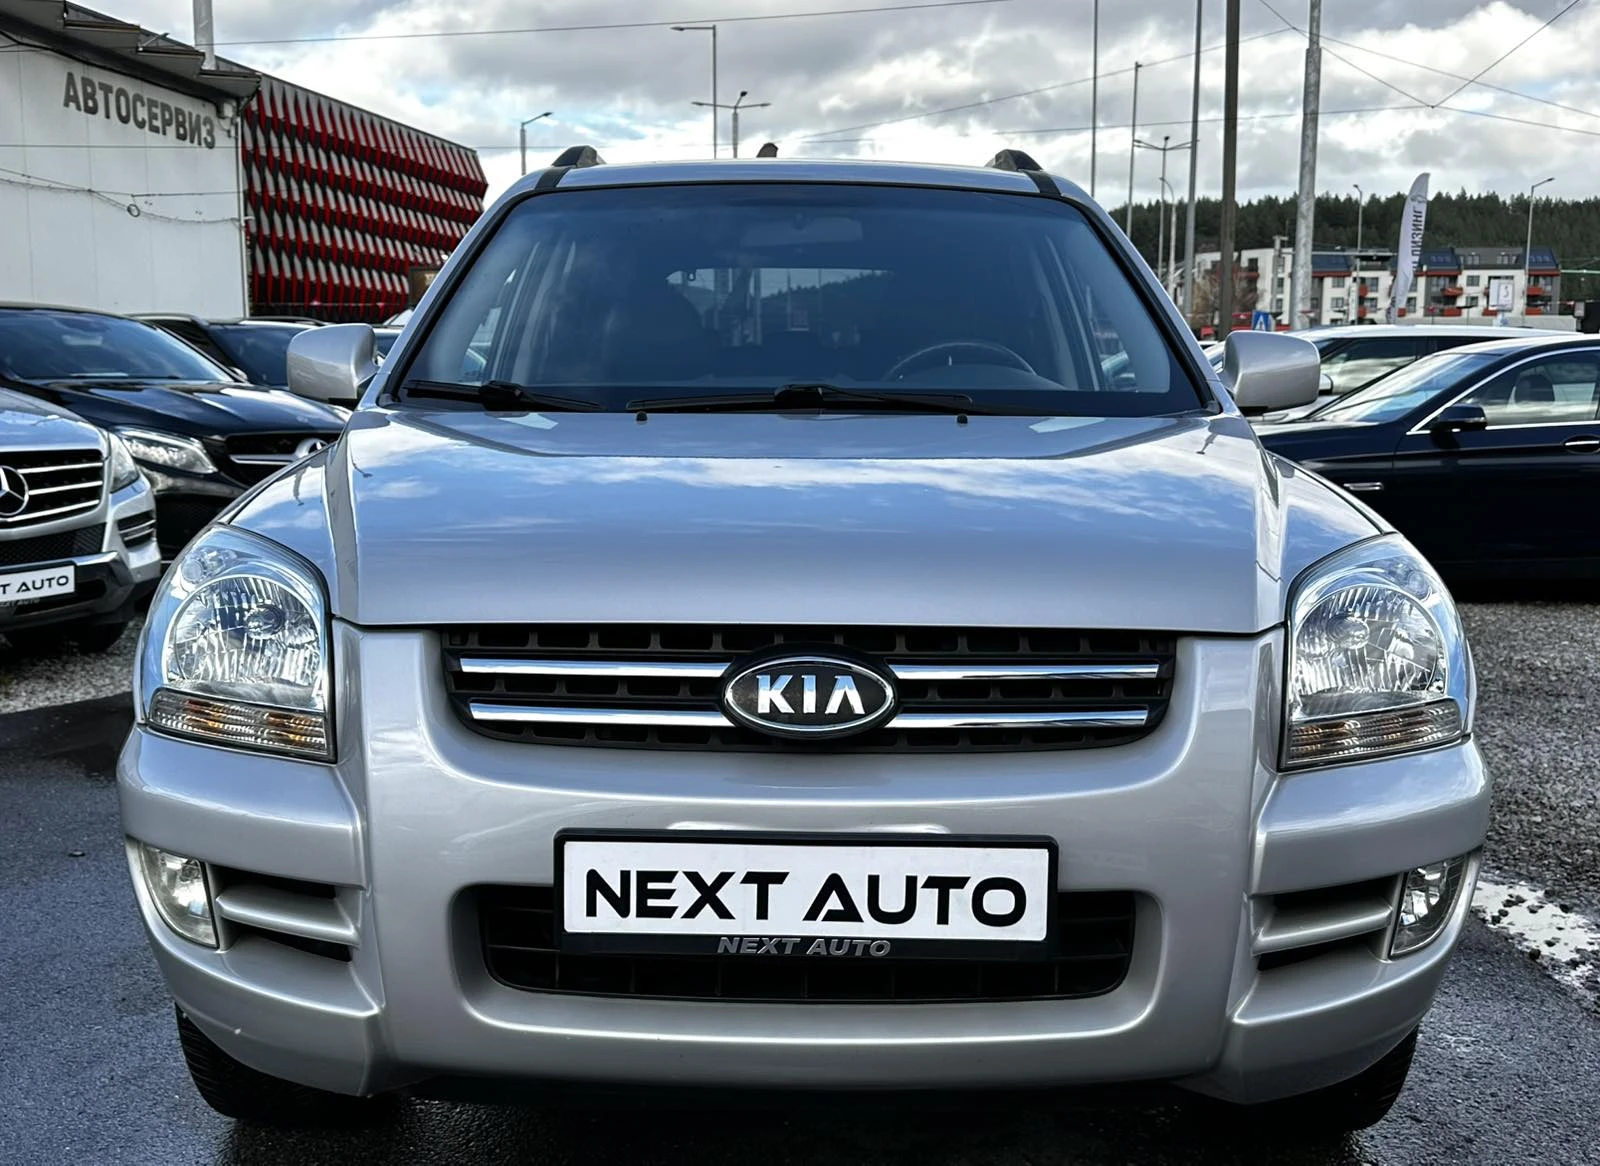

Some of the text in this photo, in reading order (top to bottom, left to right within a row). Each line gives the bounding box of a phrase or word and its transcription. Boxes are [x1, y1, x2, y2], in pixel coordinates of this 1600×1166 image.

[63, 72, 215, 149] АВТОСЕРВИЗ
[16, 575, 69, 593] AUTO
[756, 674, 865, 714] KIA
[585, 868, 1027, 928] NEXT AUTO
[717, 937, 892, 957] NEXT AUTO
